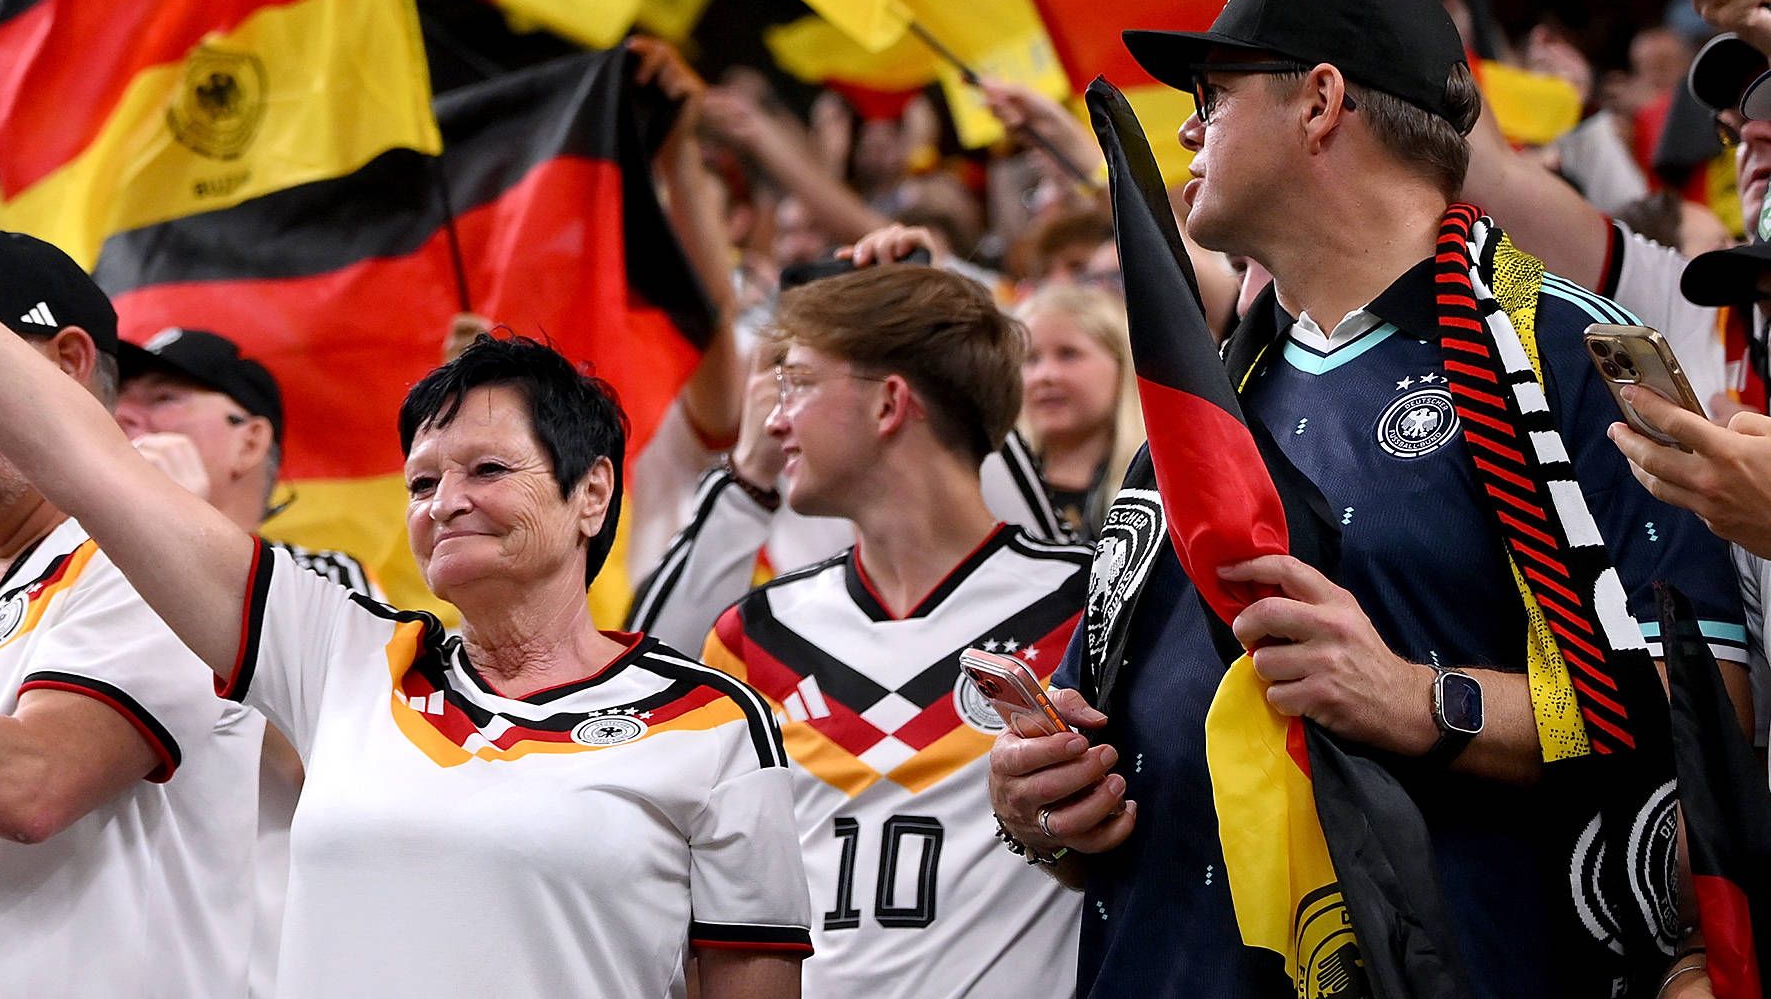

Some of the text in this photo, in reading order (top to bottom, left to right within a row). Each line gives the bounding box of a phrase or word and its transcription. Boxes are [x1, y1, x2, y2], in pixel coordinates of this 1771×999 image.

[1404, 398, 1448, 411] DEUTSCHER
[1389, 430, 1442, 449] FUSSBALL-BUND
[1105, 511, 1150, 530] SCHER
[824, 814, 945, 931] 10
